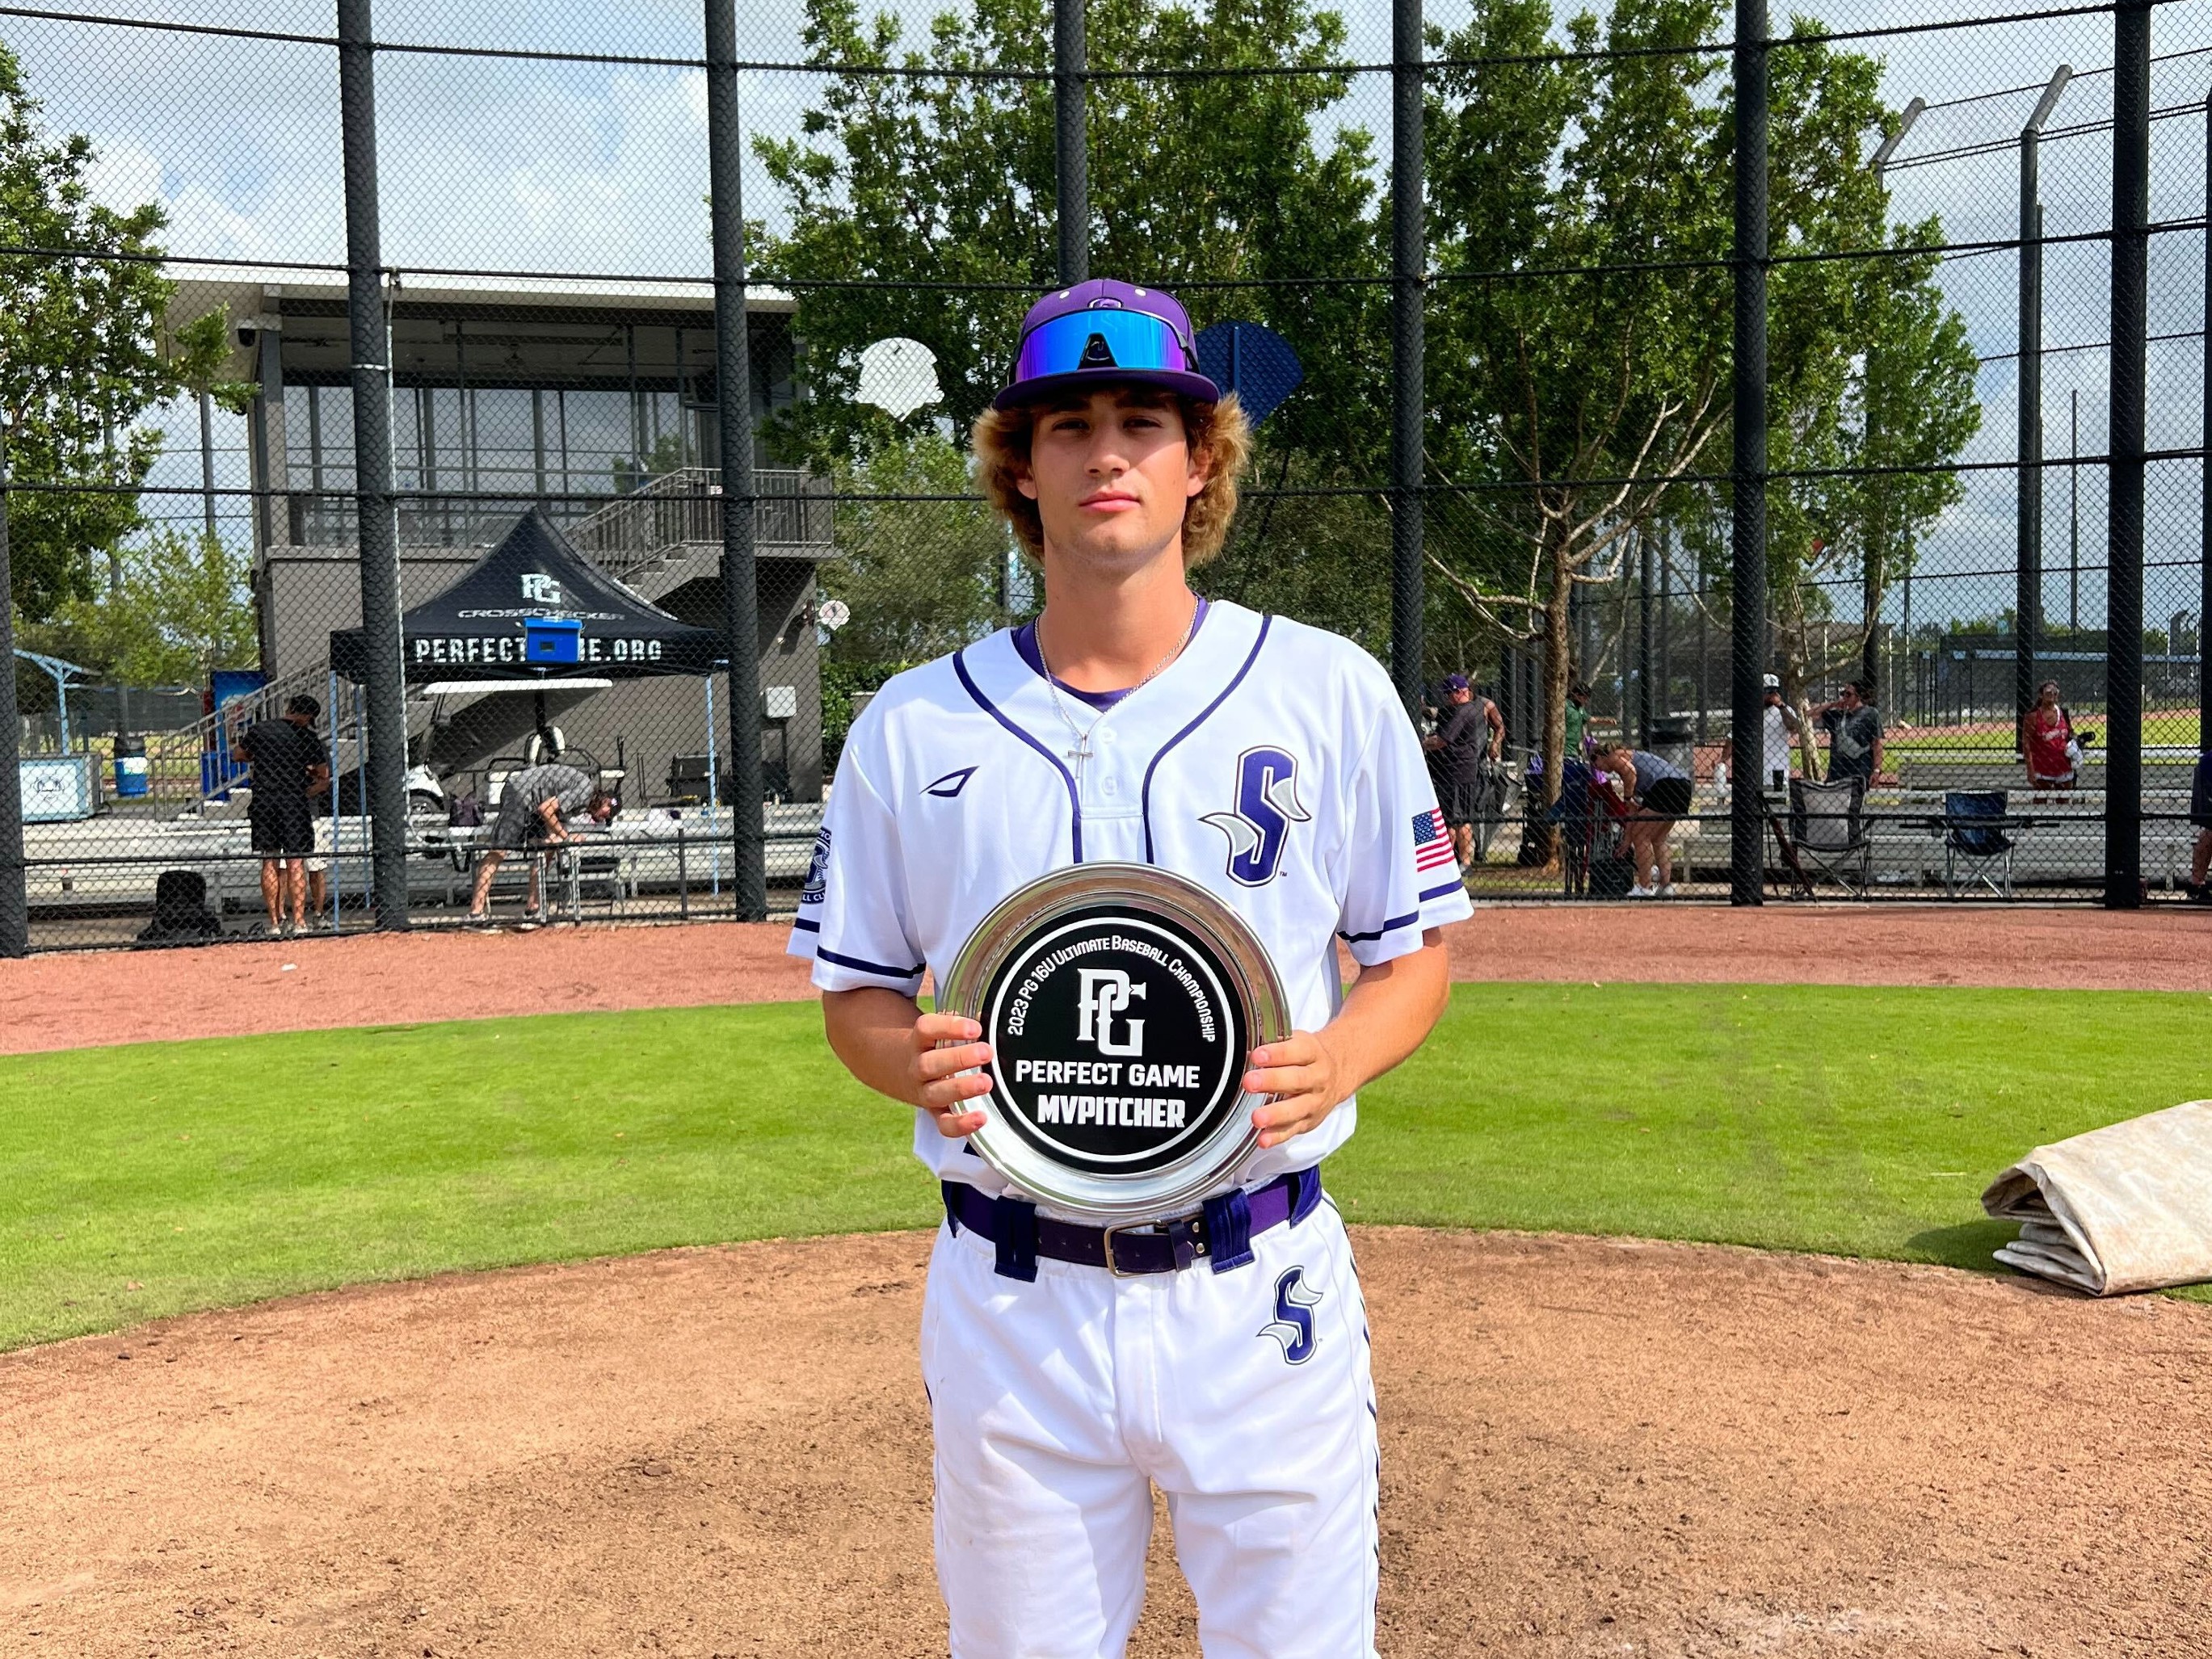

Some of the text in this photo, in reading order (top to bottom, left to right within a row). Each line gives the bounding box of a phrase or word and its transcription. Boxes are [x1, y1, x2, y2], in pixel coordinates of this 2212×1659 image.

[521, 573, 561, 603] PG
[1007, 998, 1029, 1035] 2023
[1018, 979, 1039, 1001] PG
[1031, 957, 1057, 982] 16U
[1077, 968, 1146, 1057] PG
[1015, 1059, 1201, 1088] PERFECT GAME
[1037, 1094, 1186, 1128] MVPITCHER
